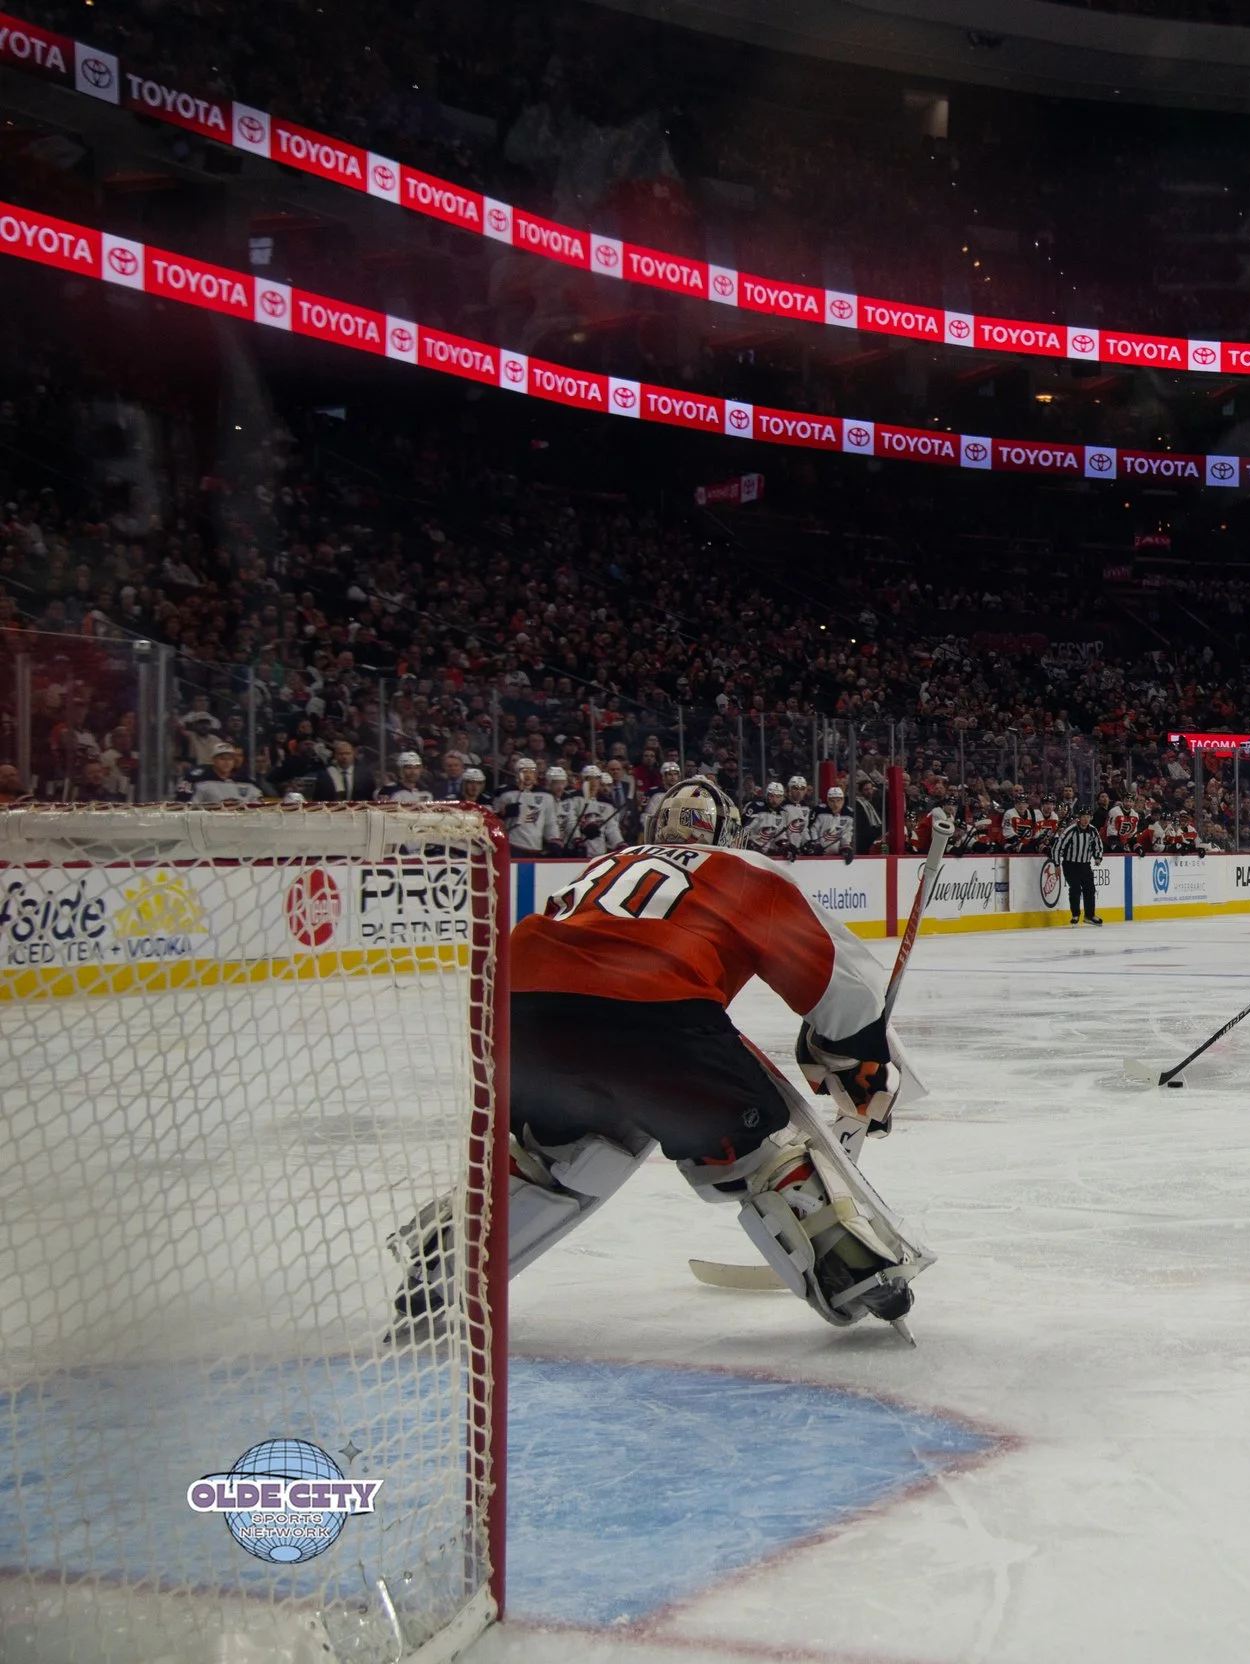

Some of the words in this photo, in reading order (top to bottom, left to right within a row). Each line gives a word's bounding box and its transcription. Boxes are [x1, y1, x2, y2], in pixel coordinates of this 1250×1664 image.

[128, 74, 225, 130] TOYOTA
[278, 130, 361, 178] TOYOTA
[407, 178, 478, 220] TOYOTA
[518, 220, 583, 258] TOYOTA
[630, 254, 702, 288] TOYOTA
[744, 283, 818, 313] TOYOTA
[864, 306, 938, 333] TOYOTA
[981, 325, 1060, 348] TOYOTA
[1106, 339, 1181, 361] TOYOTA
[153, 260, 247, 306] TOYOTA
[300, 305, 379, 342] TOYOTA
[424, 338, 494, 374] TOYOTA
[534, 369, 601, 401] TOYOTA
[647, 394, 718, 423] TOYOTA
[760, 416, 835, 441] TOYOTA
[882, 433, 954, 457] TOYOTA
[999, 447, 1077, 468] TOYOTA
[1124, 457, 1198, 477] TOYOTA
[1190, 740, 1237, 751] TACOMA
[812, 887, 867, 909] tellation
[361, 919, 468, 944] PARTNER
